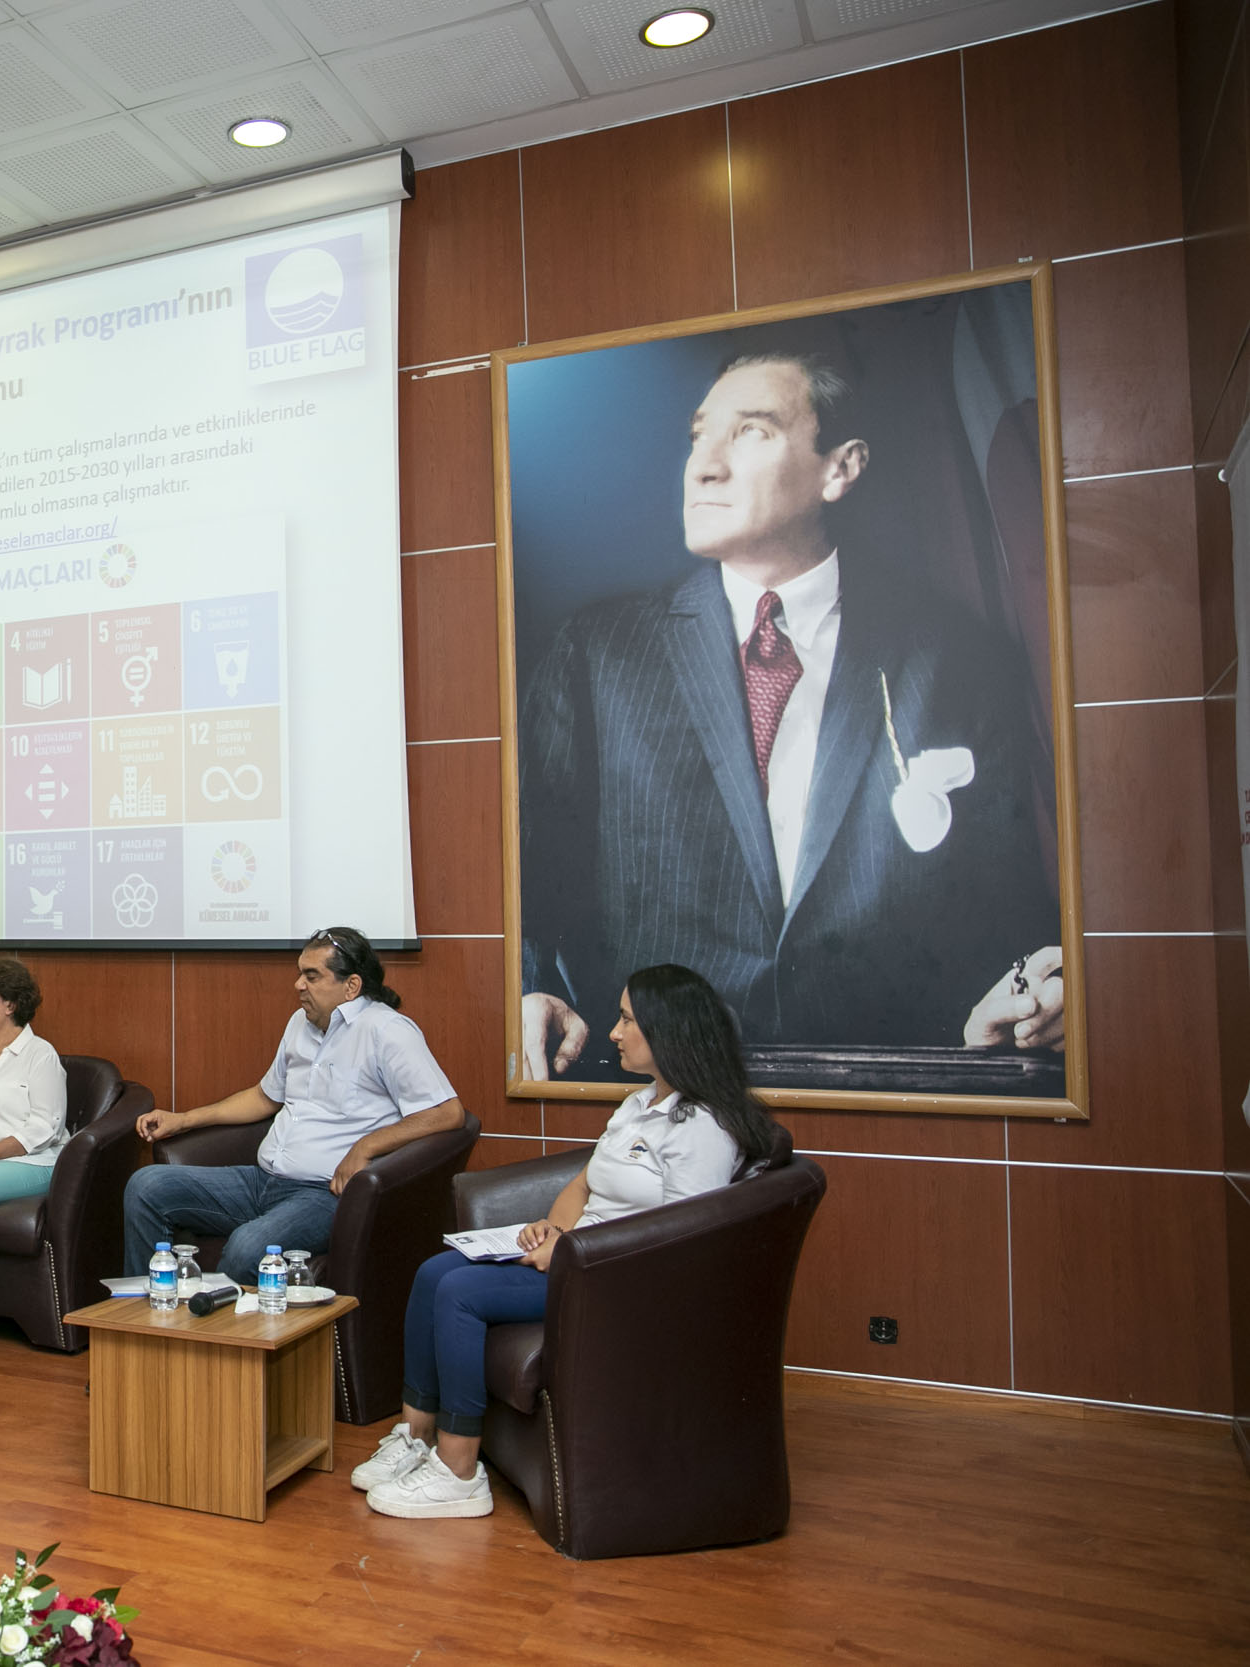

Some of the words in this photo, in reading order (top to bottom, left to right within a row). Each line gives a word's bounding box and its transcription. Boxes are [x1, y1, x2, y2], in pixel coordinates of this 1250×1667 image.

[53, 286, 233, 344] Programı'nın
[247, 343, 302, 371] BLUE
[307, 331, 365, 360] FLAG
[23, 447, 54, 464] tüm
[57, 424, 168, 463] çalışmalarında
[172, 425, 191, 439] ve
[195, 400, 317, 435] etkinliklerinde
[39, 459, 119, 487] 2015-2030
[123, 452, 166, 476] yılları
[170, 437, 254, 466] arasındaki
[31, 492, 99, 516] olmasına
[102, 479, 190, 507] çalışmaktır.
[98, 620, 109, 643] 5
[189, 609, 201, 632] 6
[10, 631, 21, 652] 4
[98, 729, 115, 753] 11
[189, 721, 210, 745] 12
[10, 734, 30, 757] 10
[8, 843, 27, 865] 16
[97, 839, 115, 864] 17
